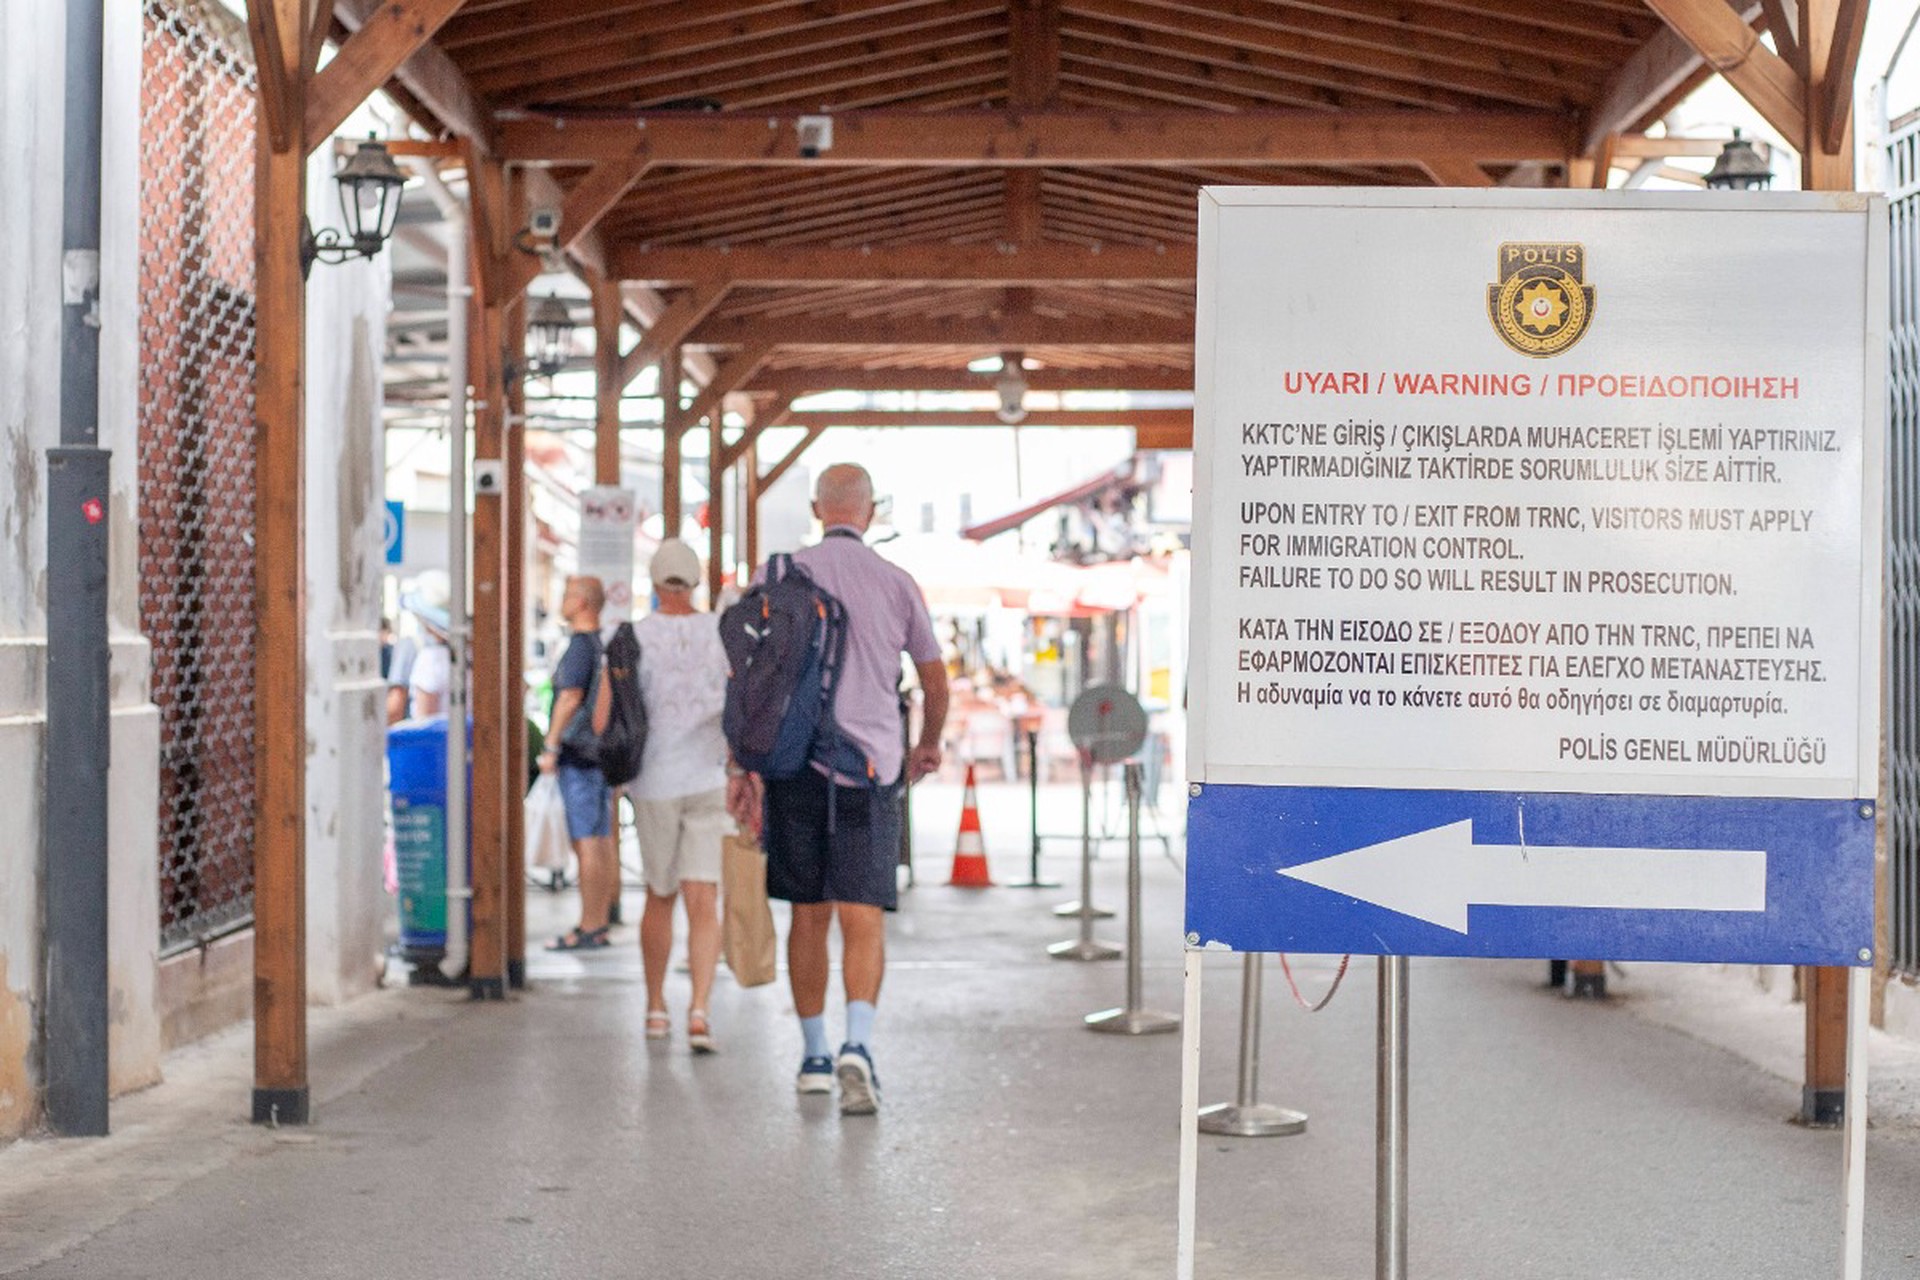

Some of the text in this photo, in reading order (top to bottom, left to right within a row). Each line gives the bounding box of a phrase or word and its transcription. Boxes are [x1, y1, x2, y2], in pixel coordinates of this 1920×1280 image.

[1508, 247, 1577, 263] POLİS
[1284, 372, 1368, 394] UYARI
[1377, 372, 1386, 394] /
[1394, 373, 1531, 396] WARNING
[1540, 375, 1548, 396] /
[1333, 419, 1385, 452] GİRİŞ
[1391, 425, 1397, 446] /
[1403, 425, 1522, 453] ÇIKIŞLARDA
[1528, 427, 1651, 448] MUHACERET
[1658, 423, 1722, 455] İŞLEMİ
[1728, 429, 1840, 451] YAPTIRINIZ.
[1241, 451, 1781, 483] YAPTIRMADIĞINIZ TAKTİRDE SORUMLULUK SİZE AİTTİR.
[1241, 502, 1813, 532] UPON ENTRY TO / EXIT FROM TRNC, VISITORS MUST APPLY
[1241, 534, 1523, 560] FOR IMMIGRATION CONTROL.
[1240, 566, 1736, 595] FAILURE TO DO SO WILL RESULT IN PROSECUTION.
[1448, 622, 1454, 643] /
[1560, 733, 1825, 765] POLİS GENEL MÜDÜRLÜĞÜ
